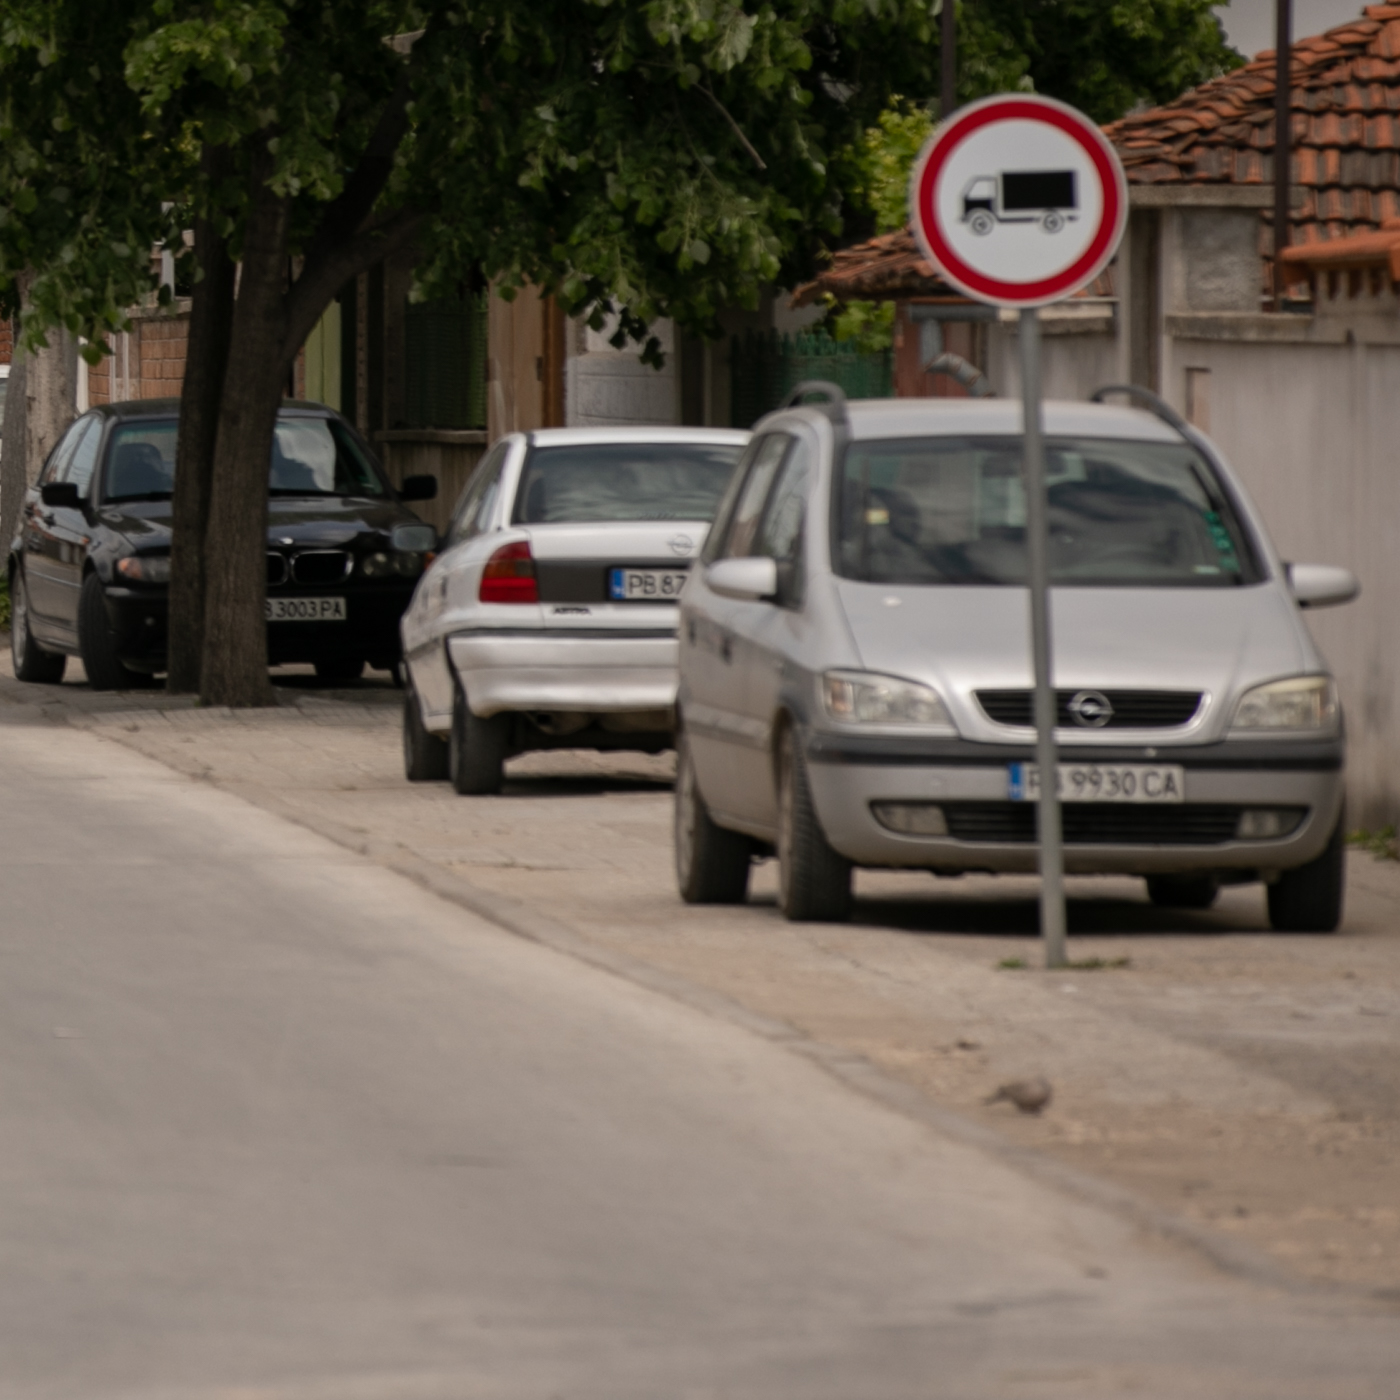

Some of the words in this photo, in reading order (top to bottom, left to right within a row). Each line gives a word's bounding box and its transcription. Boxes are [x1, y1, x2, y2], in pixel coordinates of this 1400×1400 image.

[629, 575, 656, 595] PB
[661, 575, 688, 595] 87
[276, 601, 317, 618] 3003
[1071, 769, 1136, 796] 9930
